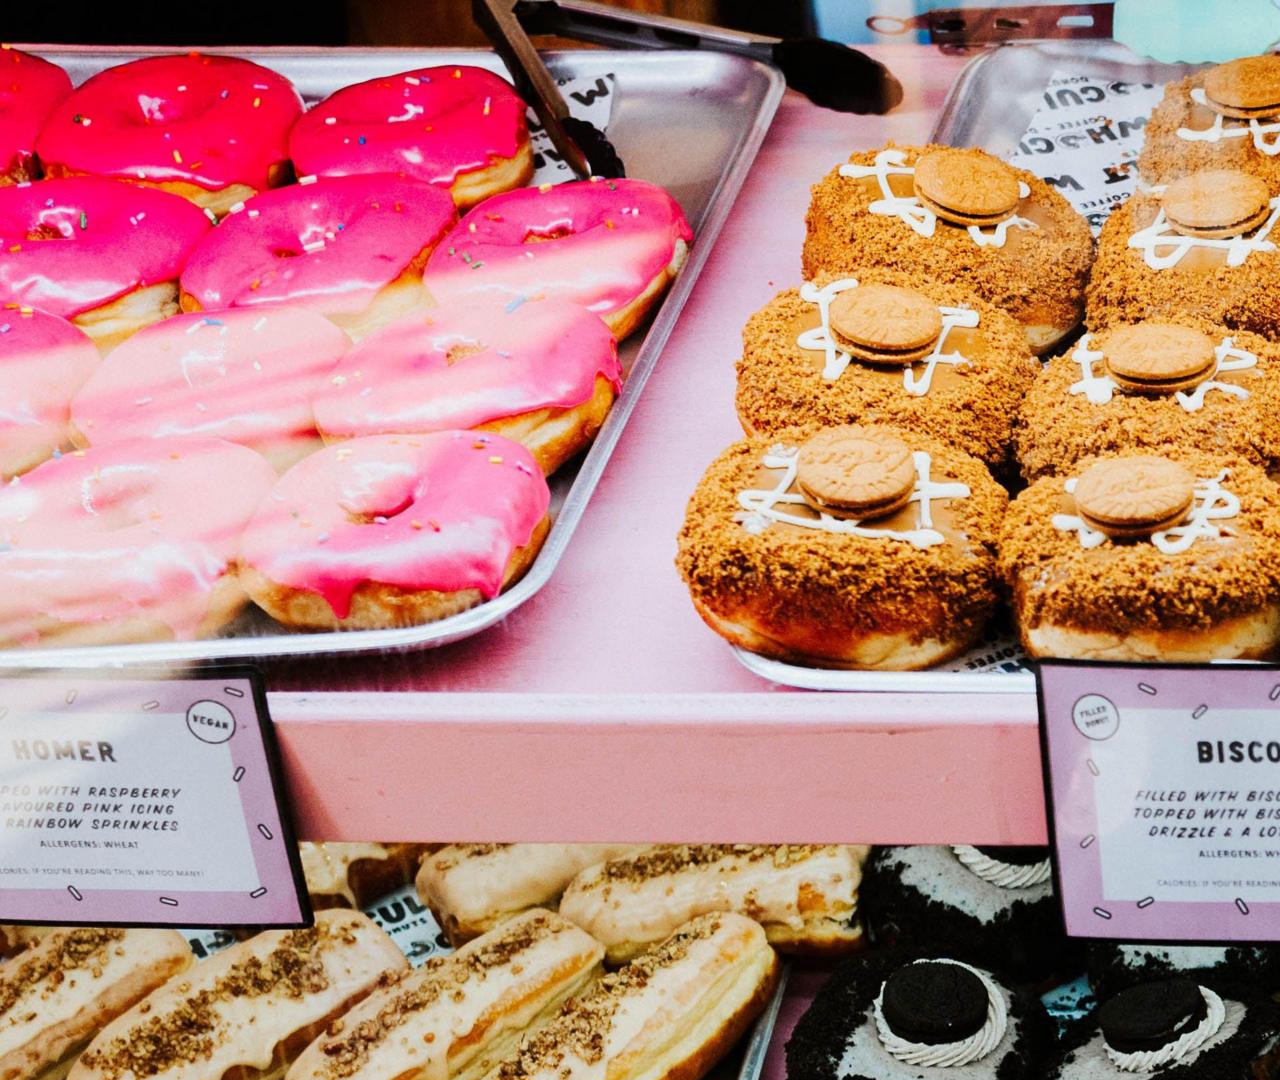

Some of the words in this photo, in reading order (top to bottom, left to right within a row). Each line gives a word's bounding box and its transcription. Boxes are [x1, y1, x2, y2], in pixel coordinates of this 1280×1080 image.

[192, 714, 229, 730] VEGAN
[12, 739, 118, 763] HOMER
[88, 786, 181, 799] RASPBERRY
[1136, 790, 1187, 803] FILLED
[1194, 790, 1239, 802] WITH
[82, 802, 123, 813] PINK
[130, 803, 174, 815] ICING
[1134, 807, 1196, 820] TOPPED
[1203, 808, 1248, 820] WITH
[5, 818, 83, 830] RAINBOW
[91, 819, 178, 831] SPRINKLES
[1148, 825, 1216, 839] DRIZZLE
[1223, 827, 1233, 838] &
[1241, 826, 1251, 837] A
